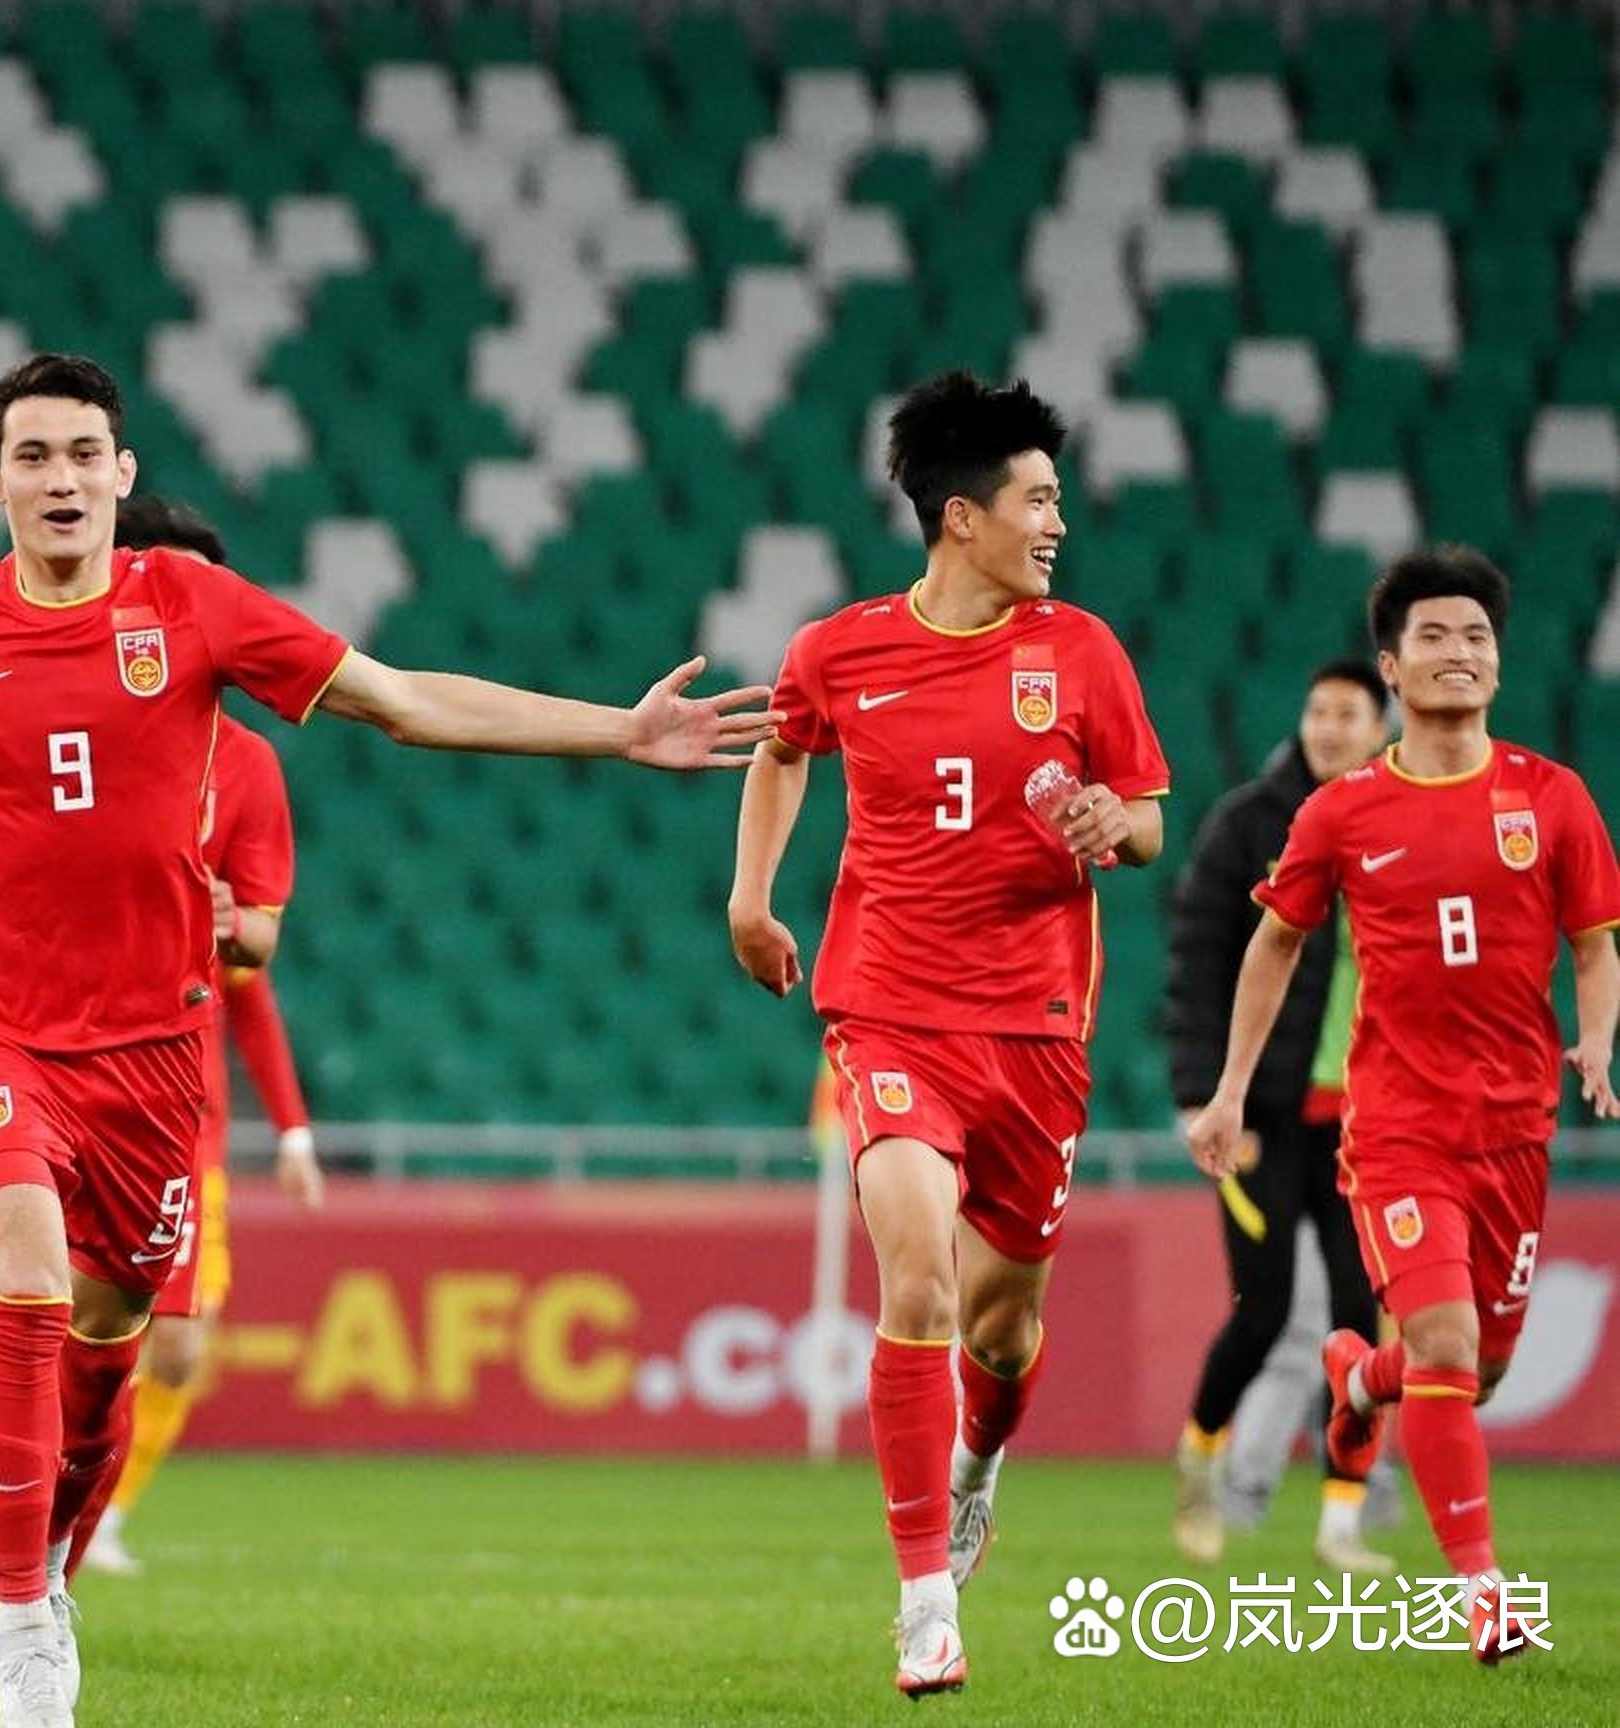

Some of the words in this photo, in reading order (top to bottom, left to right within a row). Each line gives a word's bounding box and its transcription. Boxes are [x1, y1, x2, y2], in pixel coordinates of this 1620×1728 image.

[48, 731, 94, 812] 9
[935, 757, 973, 831] 3
[1438, 895, 1479, 967] 8
[1053, 1133, 1077, 1209] 3
[148, 1175, 191, 1245] 9
[1507, 1232, 1540, 1297] 8
